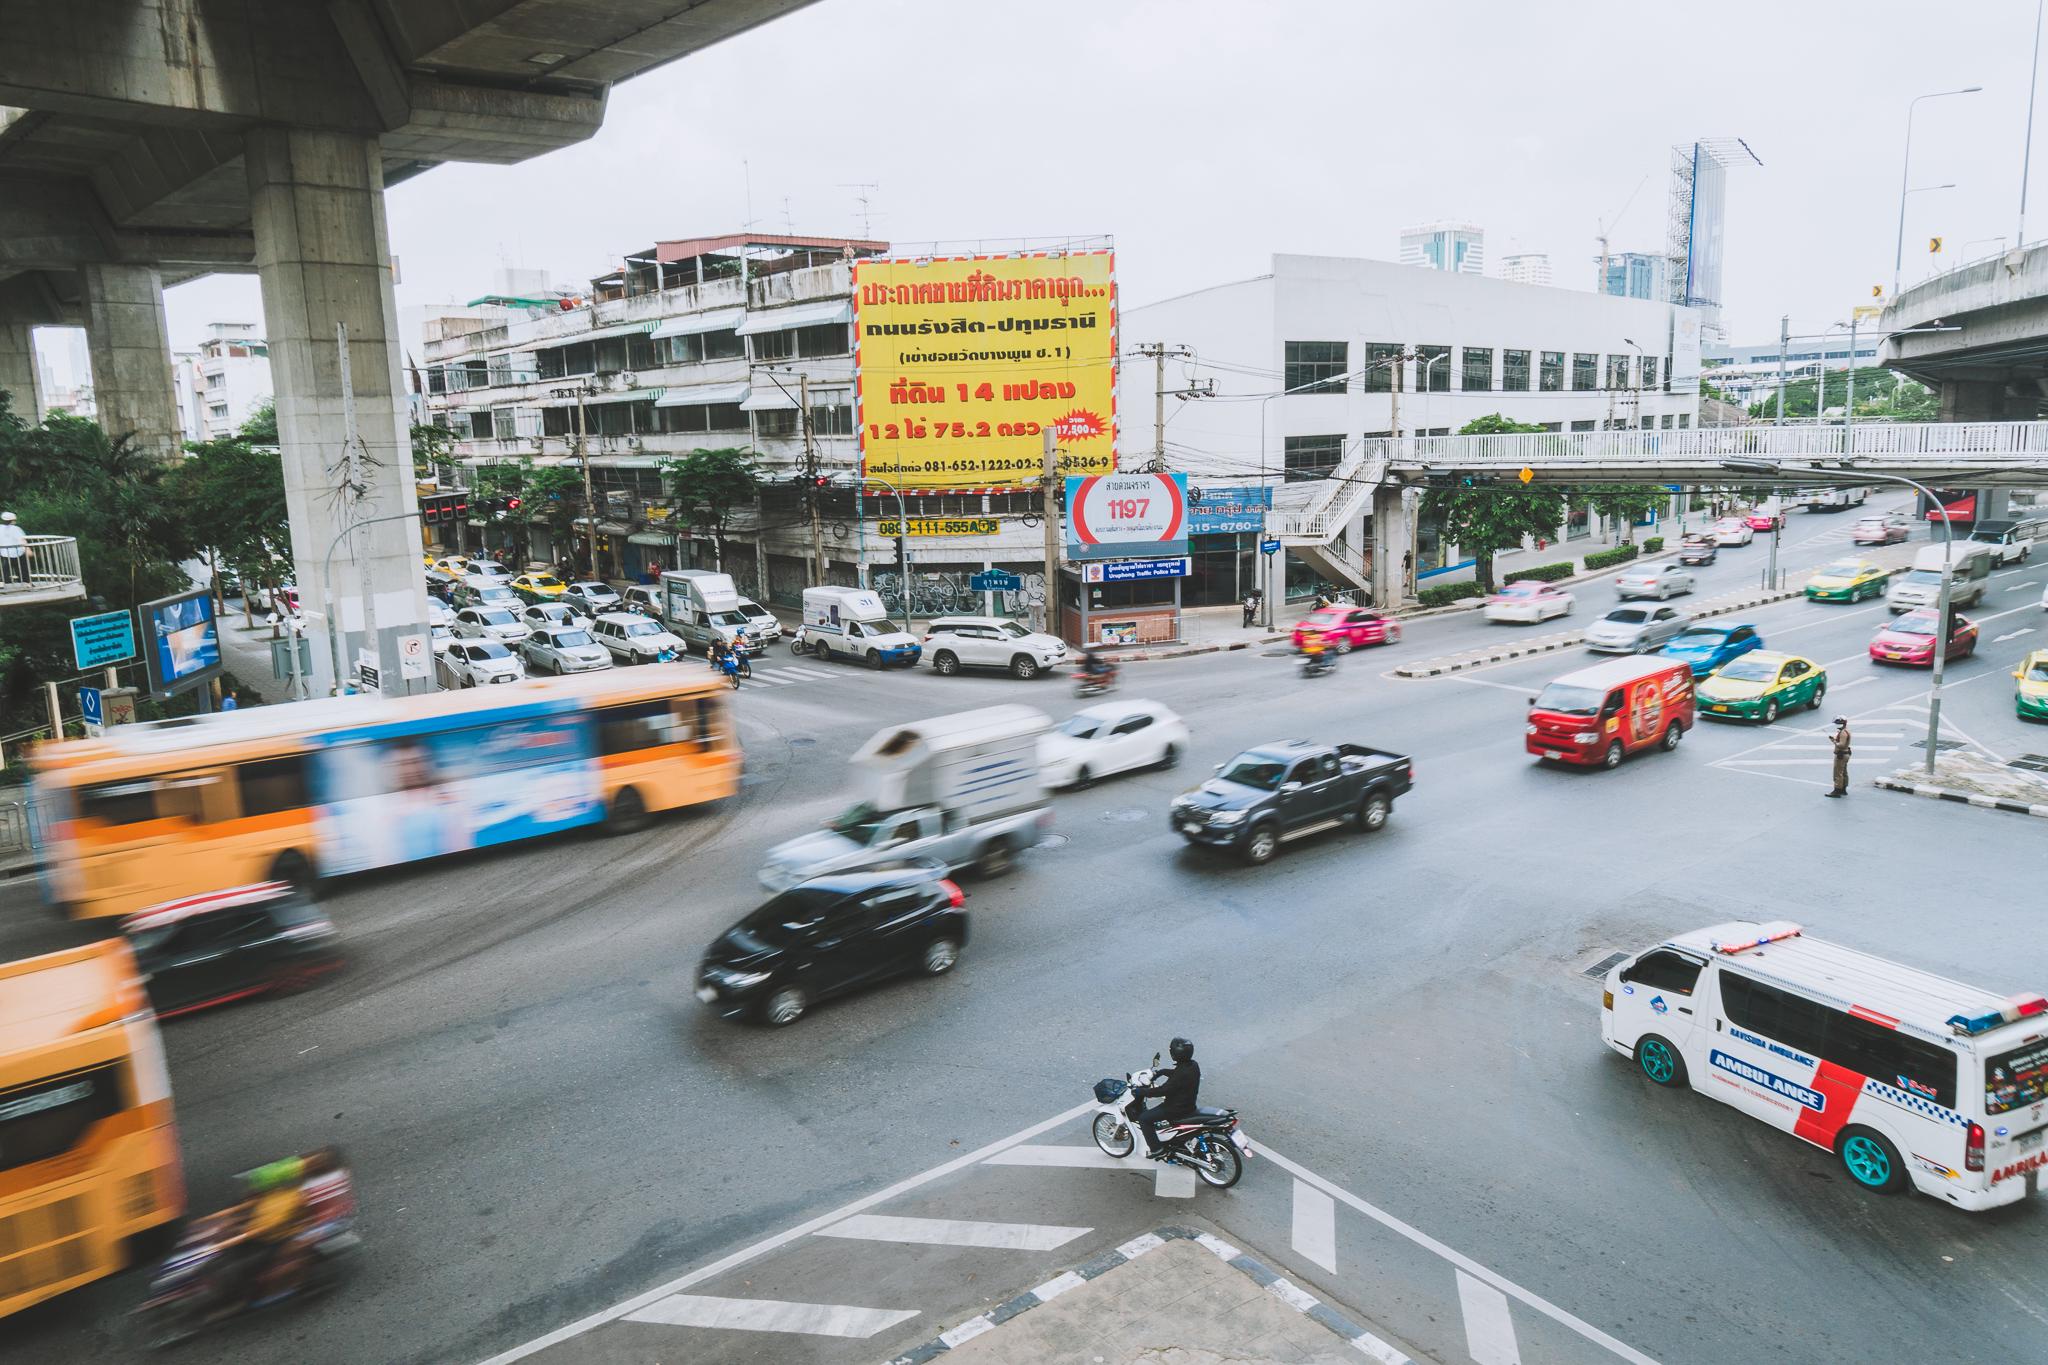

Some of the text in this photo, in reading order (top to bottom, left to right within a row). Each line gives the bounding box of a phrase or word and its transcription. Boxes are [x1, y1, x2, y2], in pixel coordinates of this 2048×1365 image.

[890, 377, 1077, 404] ที่ดิน 14 แปลง
[869, 423, 900, 440] 12
[904, 417, 927, 439] ไร่
[934, 421, 991, 438] 75.2
[1107, 498, 1150, 519] 1197
[1768, 1043, 1815, 1068] AMBULANCE
[1715, 1054, 1819, 1107] AMBULANCE
